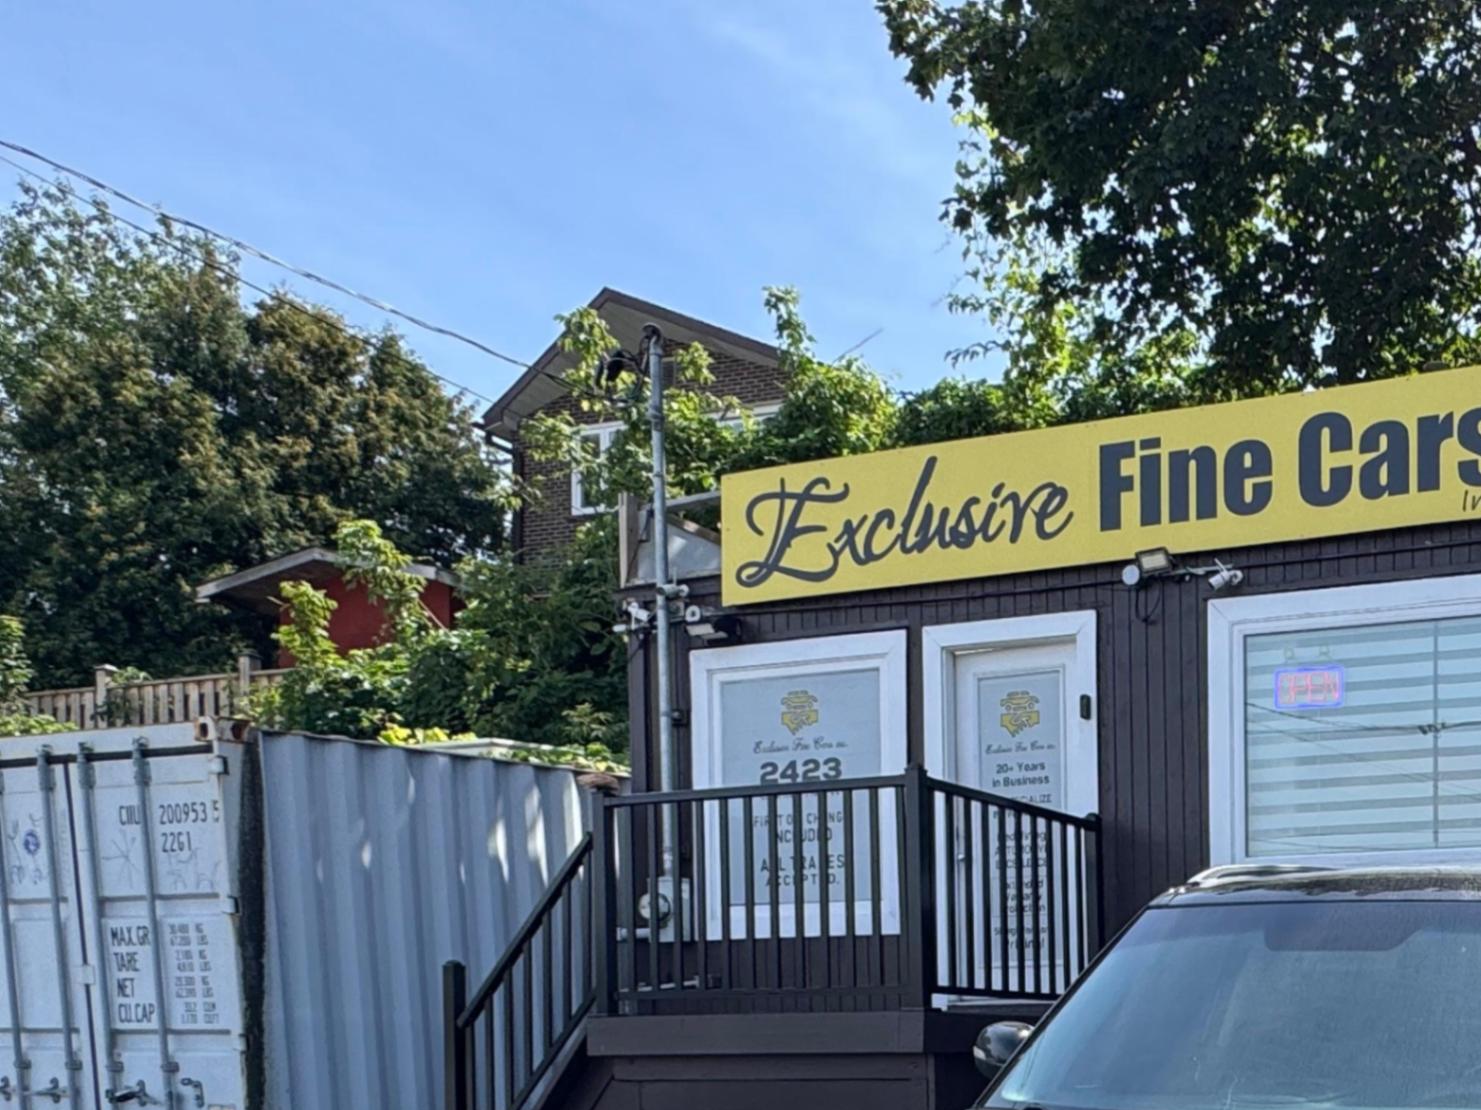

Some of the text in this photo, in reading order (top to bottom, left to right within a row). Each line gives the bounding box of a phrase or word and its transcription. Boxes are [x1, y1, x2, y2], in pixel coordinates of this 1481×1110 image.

[735, 455, 1075, 589] Exclusive
[1099, 436, 1273, 533] Fine
[760, 757, 842, 785] 2423
[1017, 762, 1046, 772] Years
[1003, 775, 1050, 787] Business
[159, 802, 208, 824] 200953
[113, 951, 140, 972] TARE
[117, 977, 135, 998] NET
